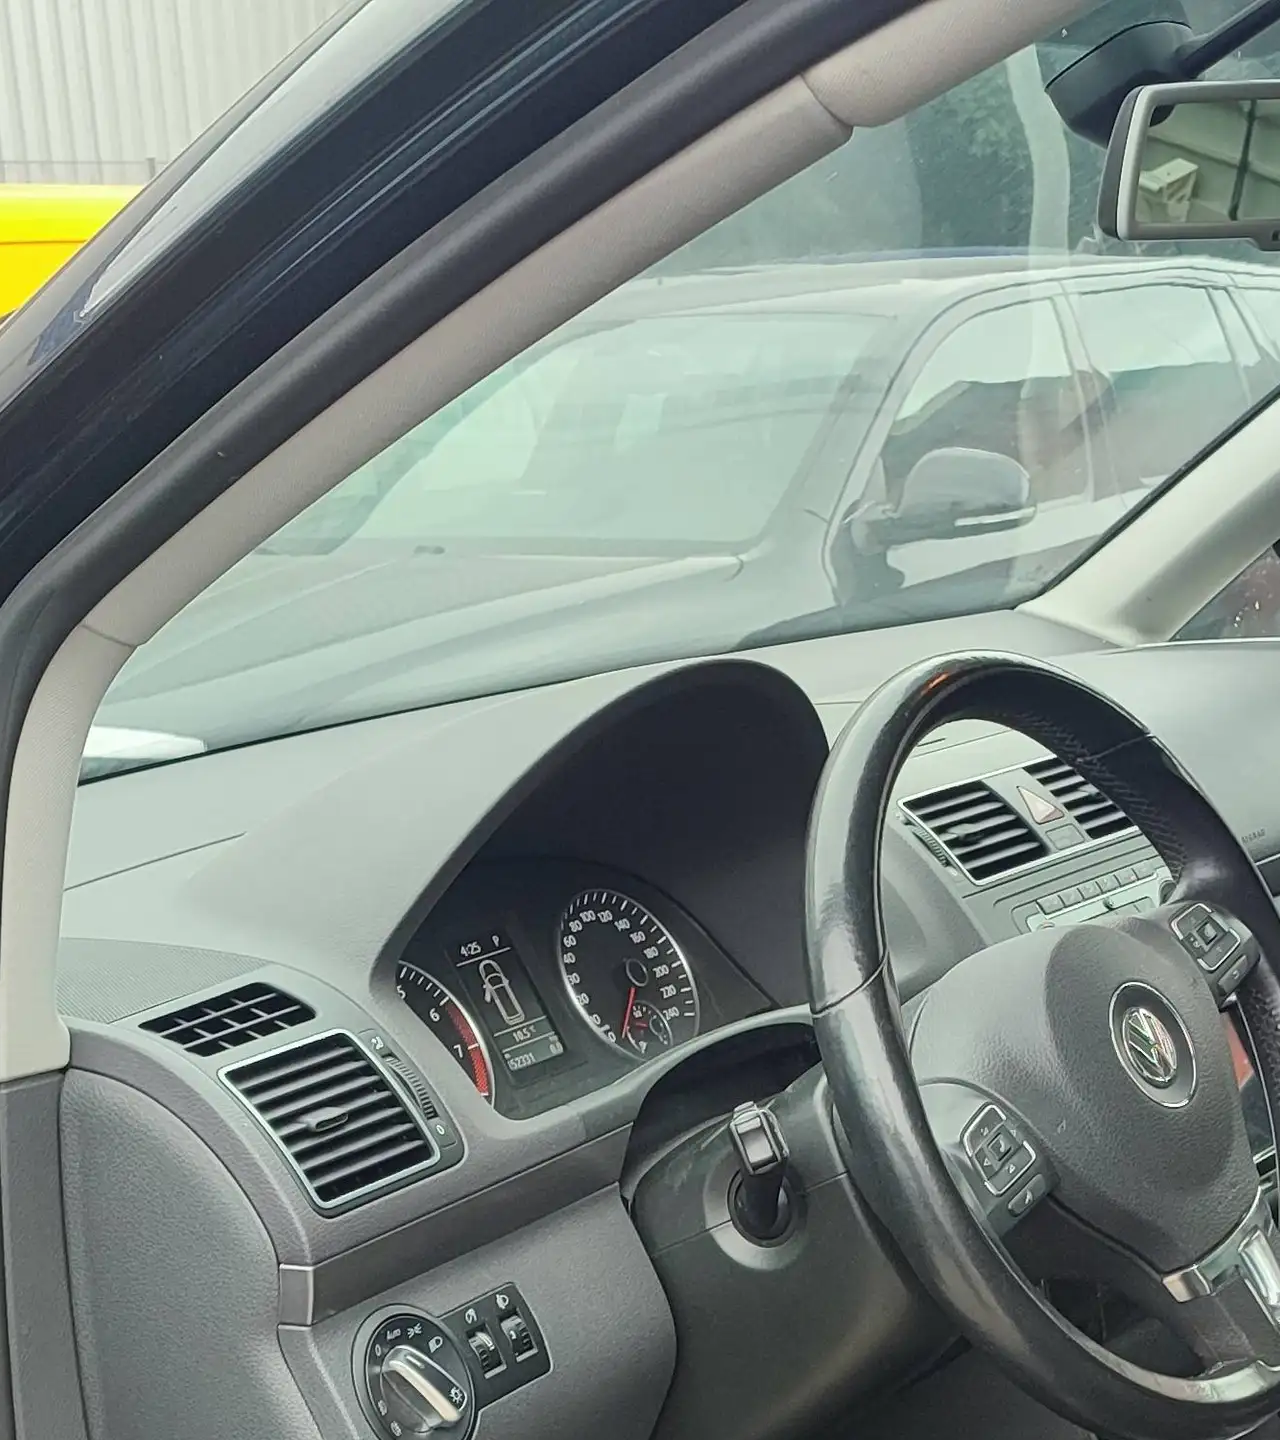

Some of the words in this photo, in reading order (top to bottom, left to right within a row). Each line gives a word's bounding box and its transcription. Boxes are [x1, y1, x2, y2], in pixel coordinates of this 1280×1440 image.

[580, 910, 596, 922] 100
[597, 910, 613, 922] 120
[569, 920, 582, 932] 80
[614, 918, 630, 932] 140
[563, 935, 576, 947] 60
[629, 931, 646, 944] 160
[460, 941, 481, 957] 4:25
[492, 935, 500, 947] P
[643, 946, 659, 959] 180
[563, 952, 576, 964] 40
[652, 964, 669, 978] 200
[396, 985, 406, 999] 5
[660, 984, 676, 998] 220
[429, 1008, 440, 1022] 6
[663, 1006, 679, 1020] 240
[608, 1031, 617, 1043] 0
[453, 1044, 463, 1059] 7
